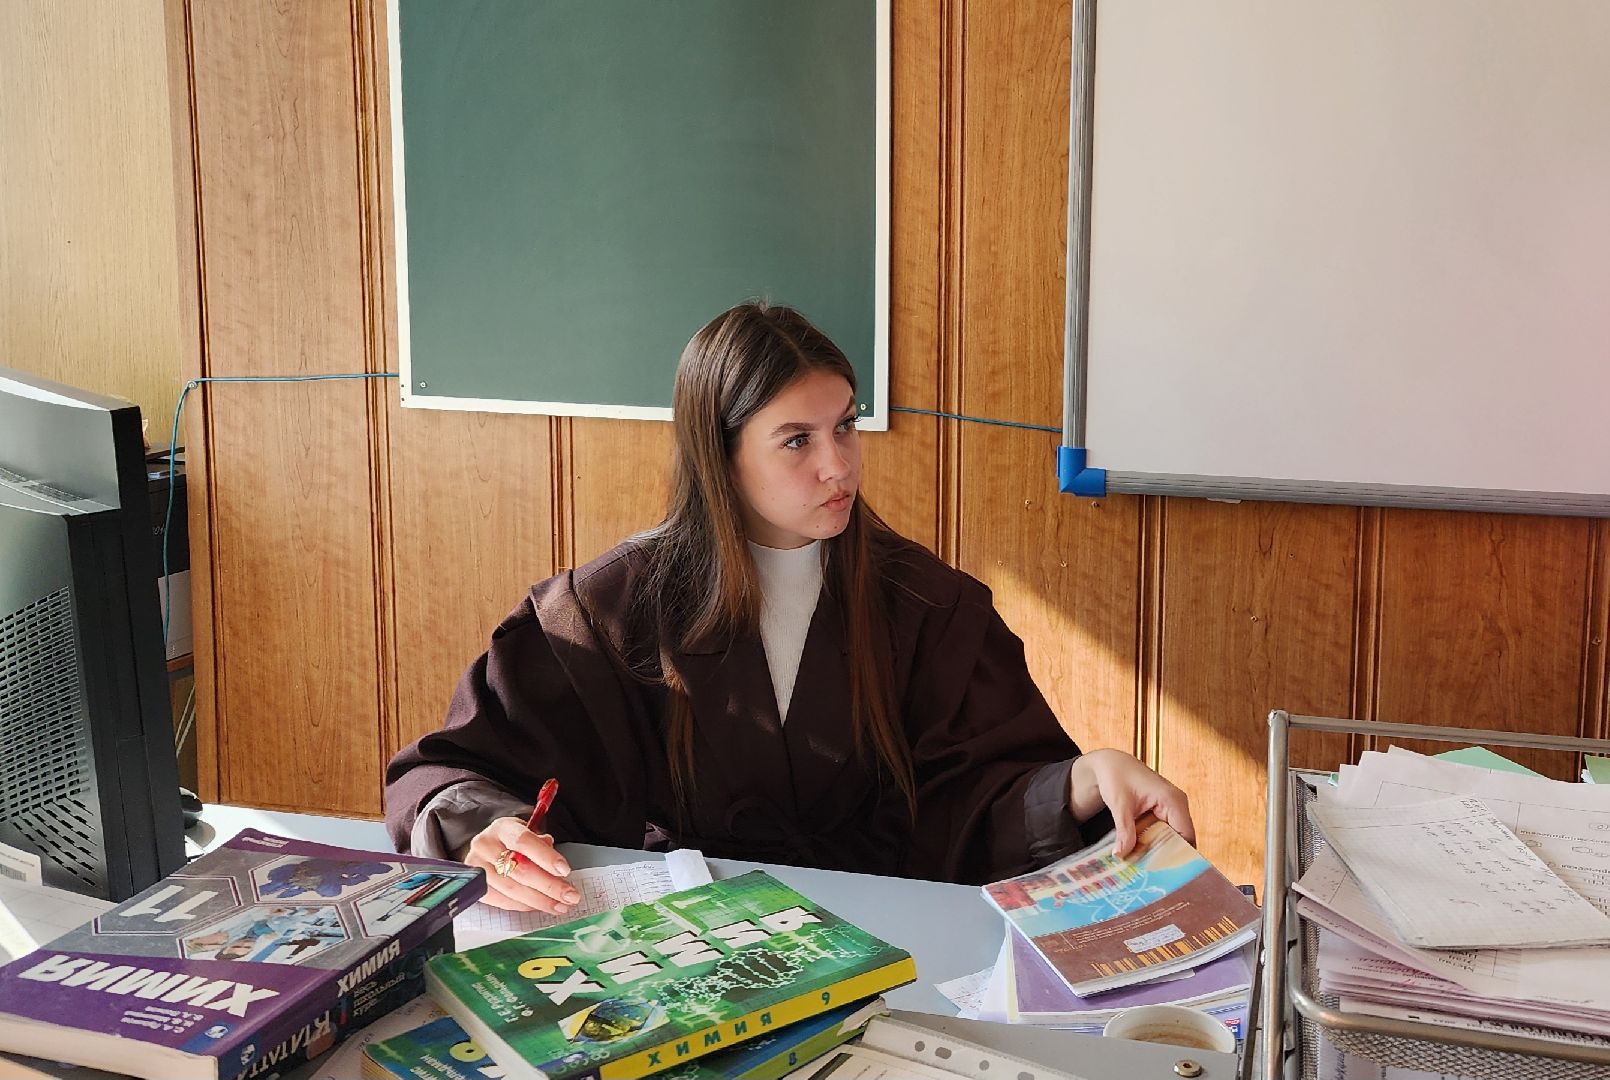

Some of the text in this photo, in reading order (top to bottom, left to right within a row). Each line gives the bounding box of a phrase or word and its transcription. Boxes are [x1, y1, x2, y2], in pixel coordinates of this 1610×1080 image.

[119, 884, 218, 923] 11
[336, 939, 401, 998] ХИМИЯ
[518, 957, 572, 979] 9
[534, 905, 822, 1006] ХИМИЯ
[18, 955, 281, 1018] ХИМИЯ
[821, 991, 831, 1006] 9
[648, 1012, 772, 1068] ХИМИЯ
